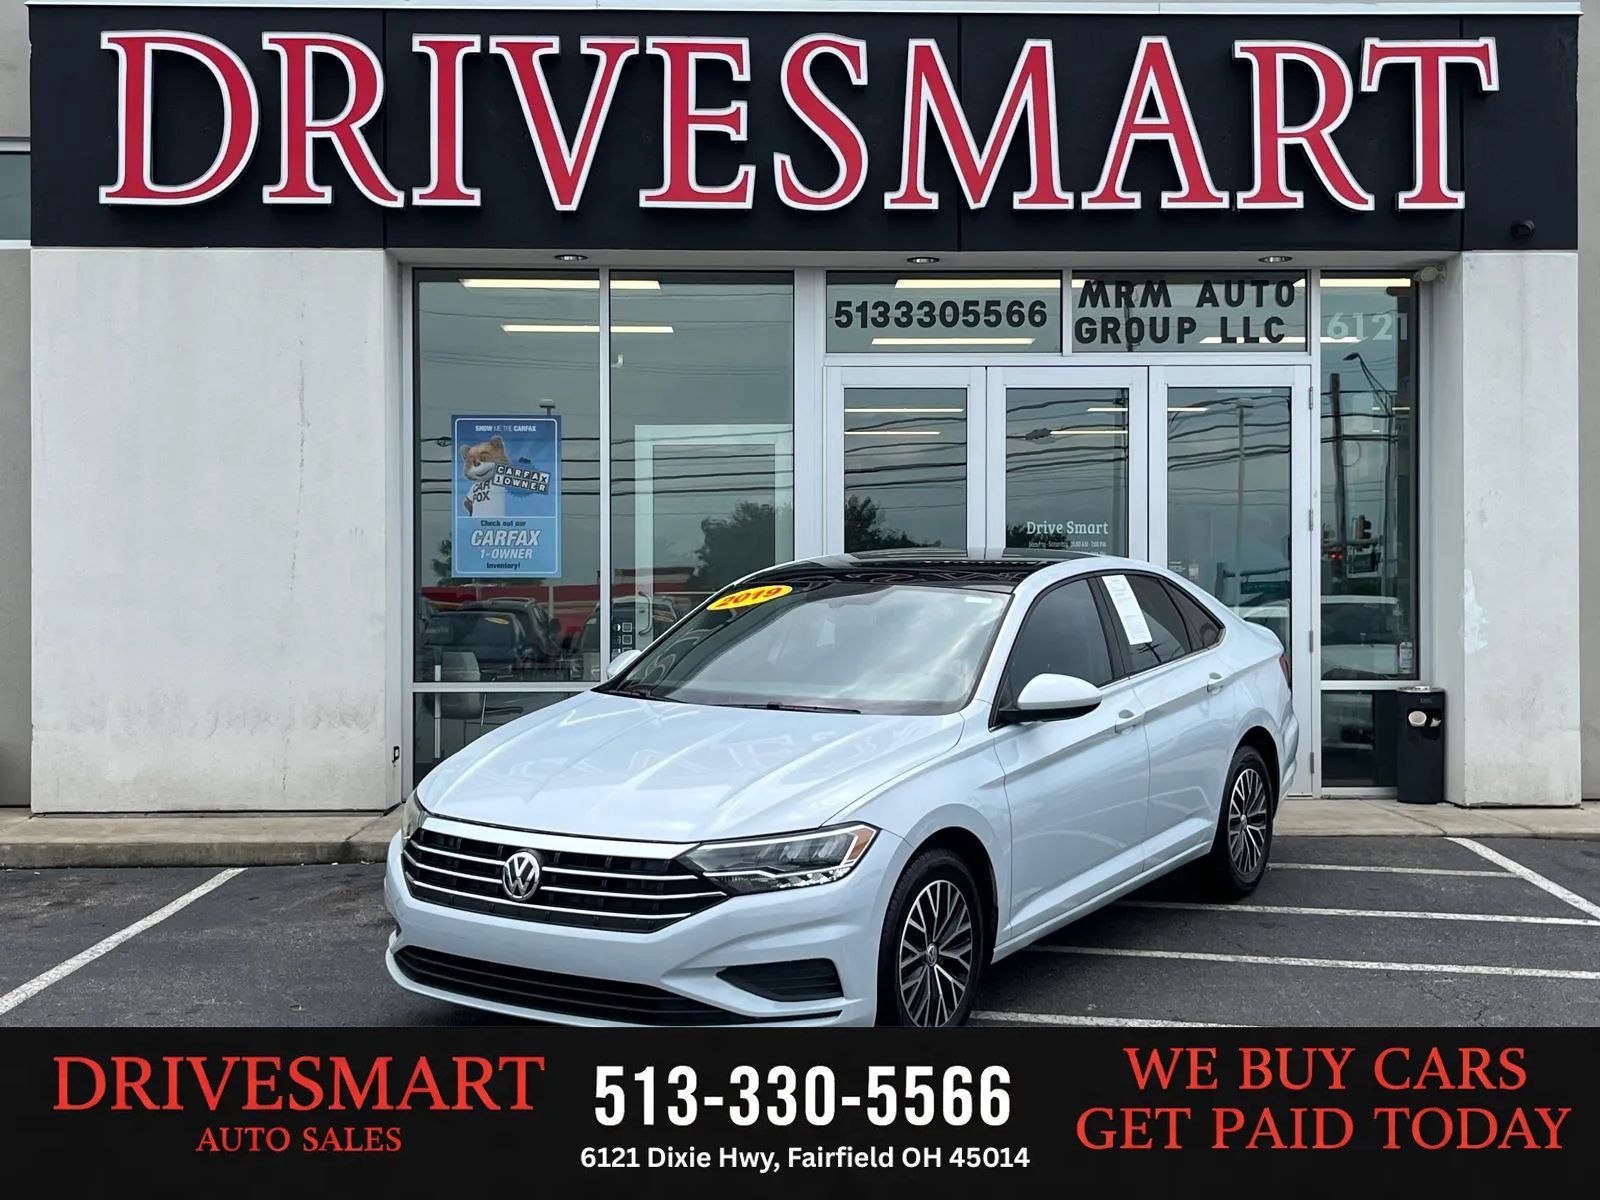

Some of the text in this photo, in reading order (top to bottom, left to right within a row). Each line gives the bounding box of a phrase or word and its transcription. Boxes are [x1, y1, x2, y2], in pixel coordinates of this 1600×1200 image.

[99, 30, 1499, 212] DRIVESMART
[1078, 279, 1295, 308] MRM AUTO
[834, 300, 1047, 329] 5133305566
[1074, 316, 1285, 345] GROUP LLC
[1326, 311, 1408, 341] 6121
[497, 466, 549, 483] CARFAX
[504, 477, 546, 492] OWNER
[472, 491, 491, 502] FOX
[1026, 520, 1109, 534] Drive Smart
[471, 530, 541, 546] CARFAX
[480, 549, 533, 559] 1-OWNER
[486, 562, 521, 570] Inventory!
[716, 587, 782, 607] 2019
